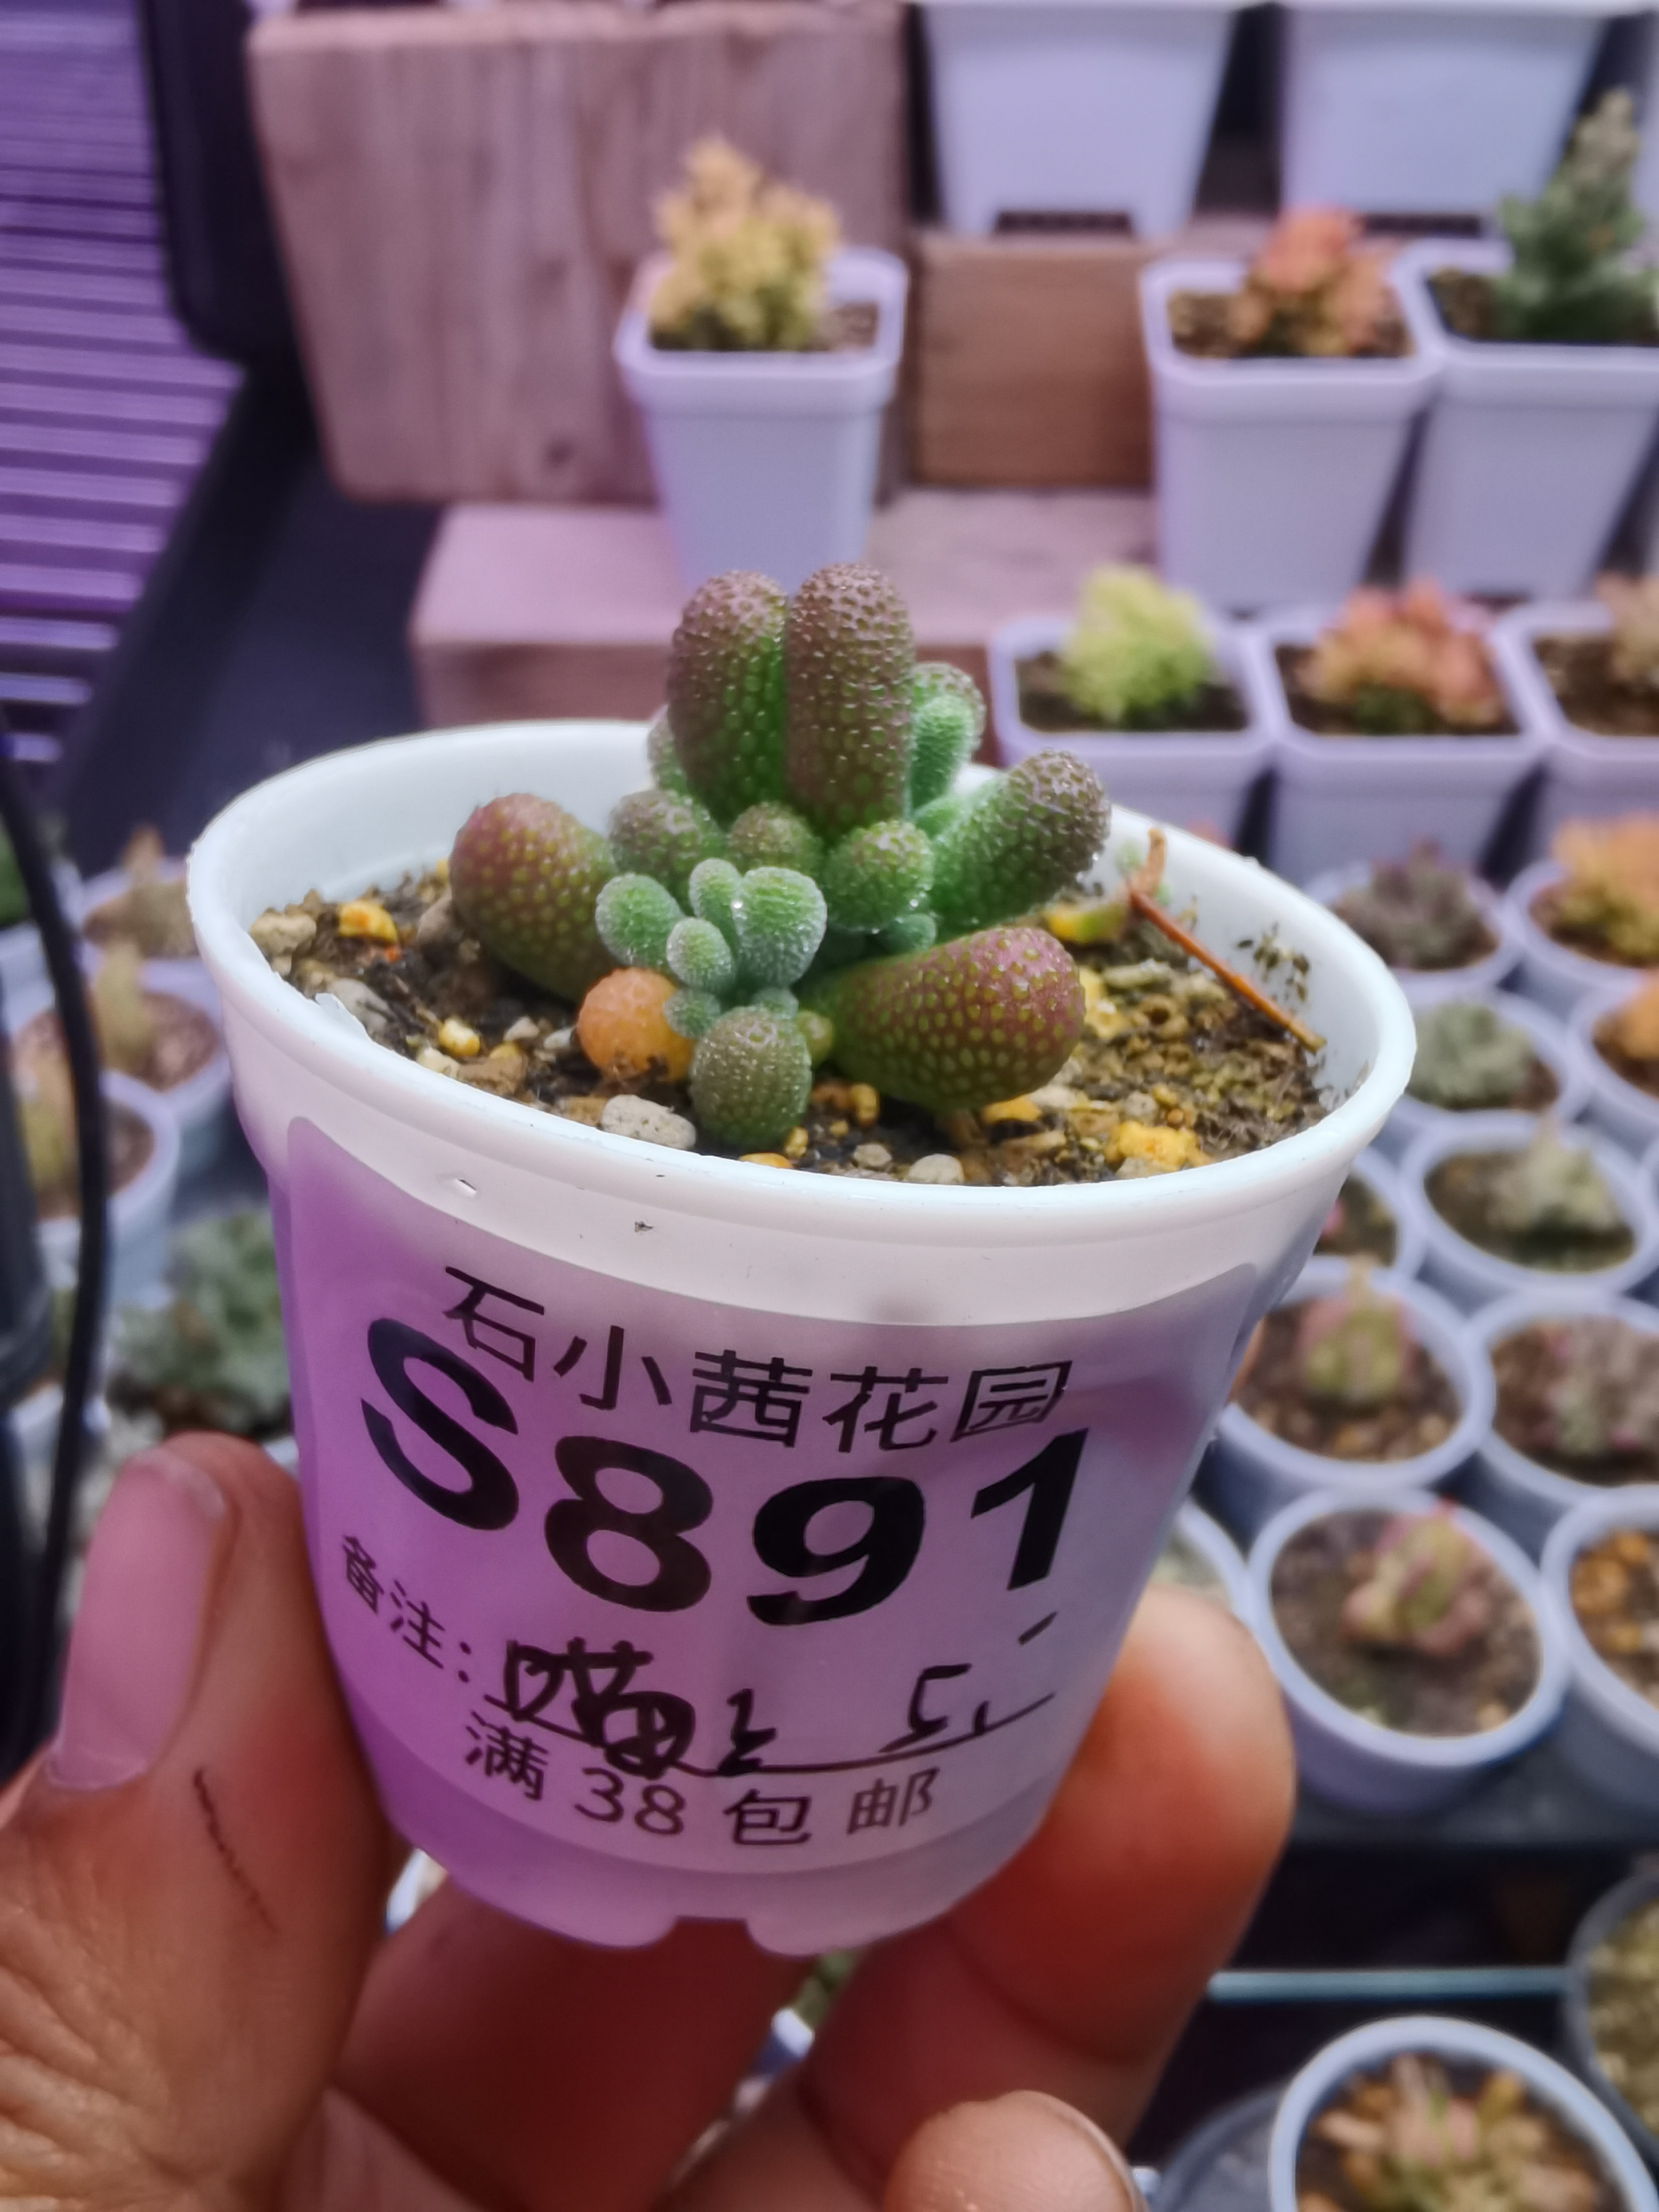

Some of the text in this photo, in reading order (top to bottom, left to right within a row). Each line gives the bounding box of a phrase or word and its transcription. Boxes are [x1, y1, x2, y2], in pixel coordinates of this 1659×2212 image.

[361, 1318, 1090, 1626] S891
[442, 1265, 1074, 1453] 石小茜花园
